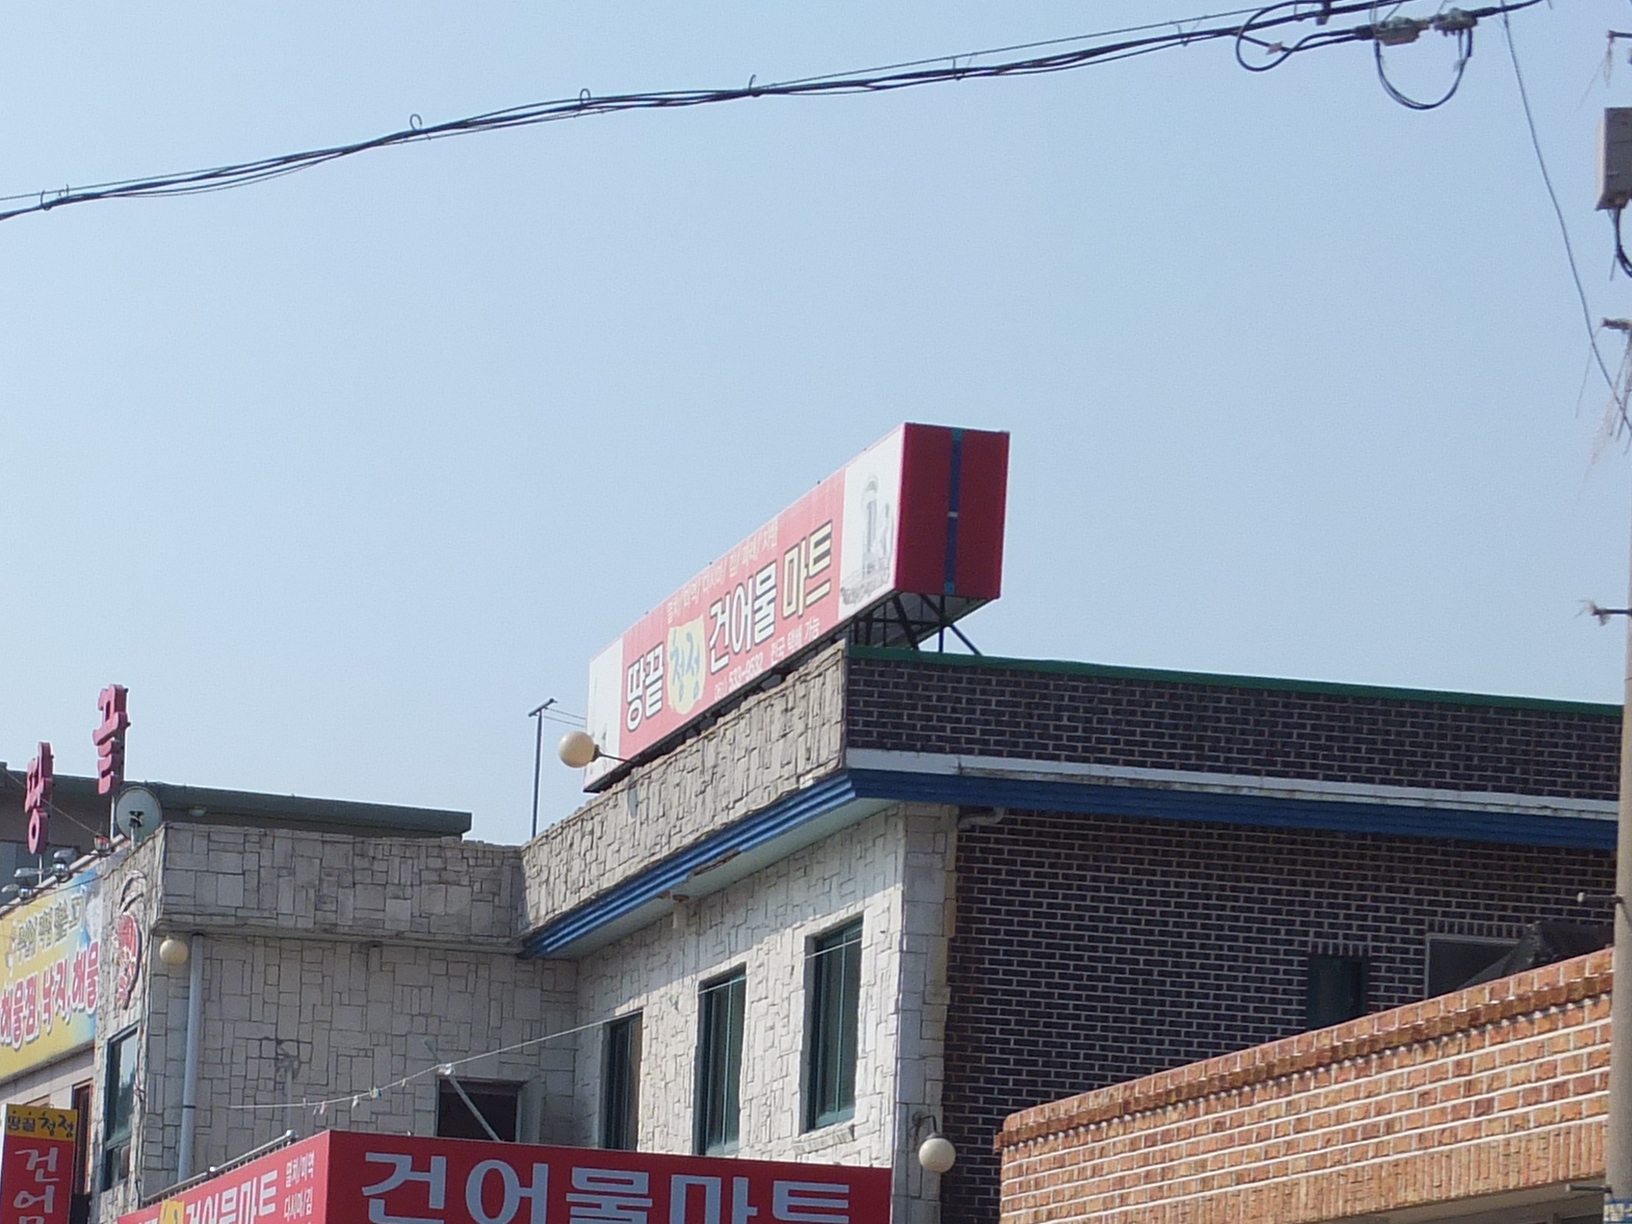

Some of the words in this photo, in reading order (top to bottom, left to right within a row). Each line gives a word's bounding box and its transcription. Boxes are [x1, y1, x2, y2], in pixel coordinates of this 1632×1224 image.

[625, 641, 665, 732] 땅끝
[709, 559, 778, 675] 건어물
[782, 518, 833, 620] 마트
